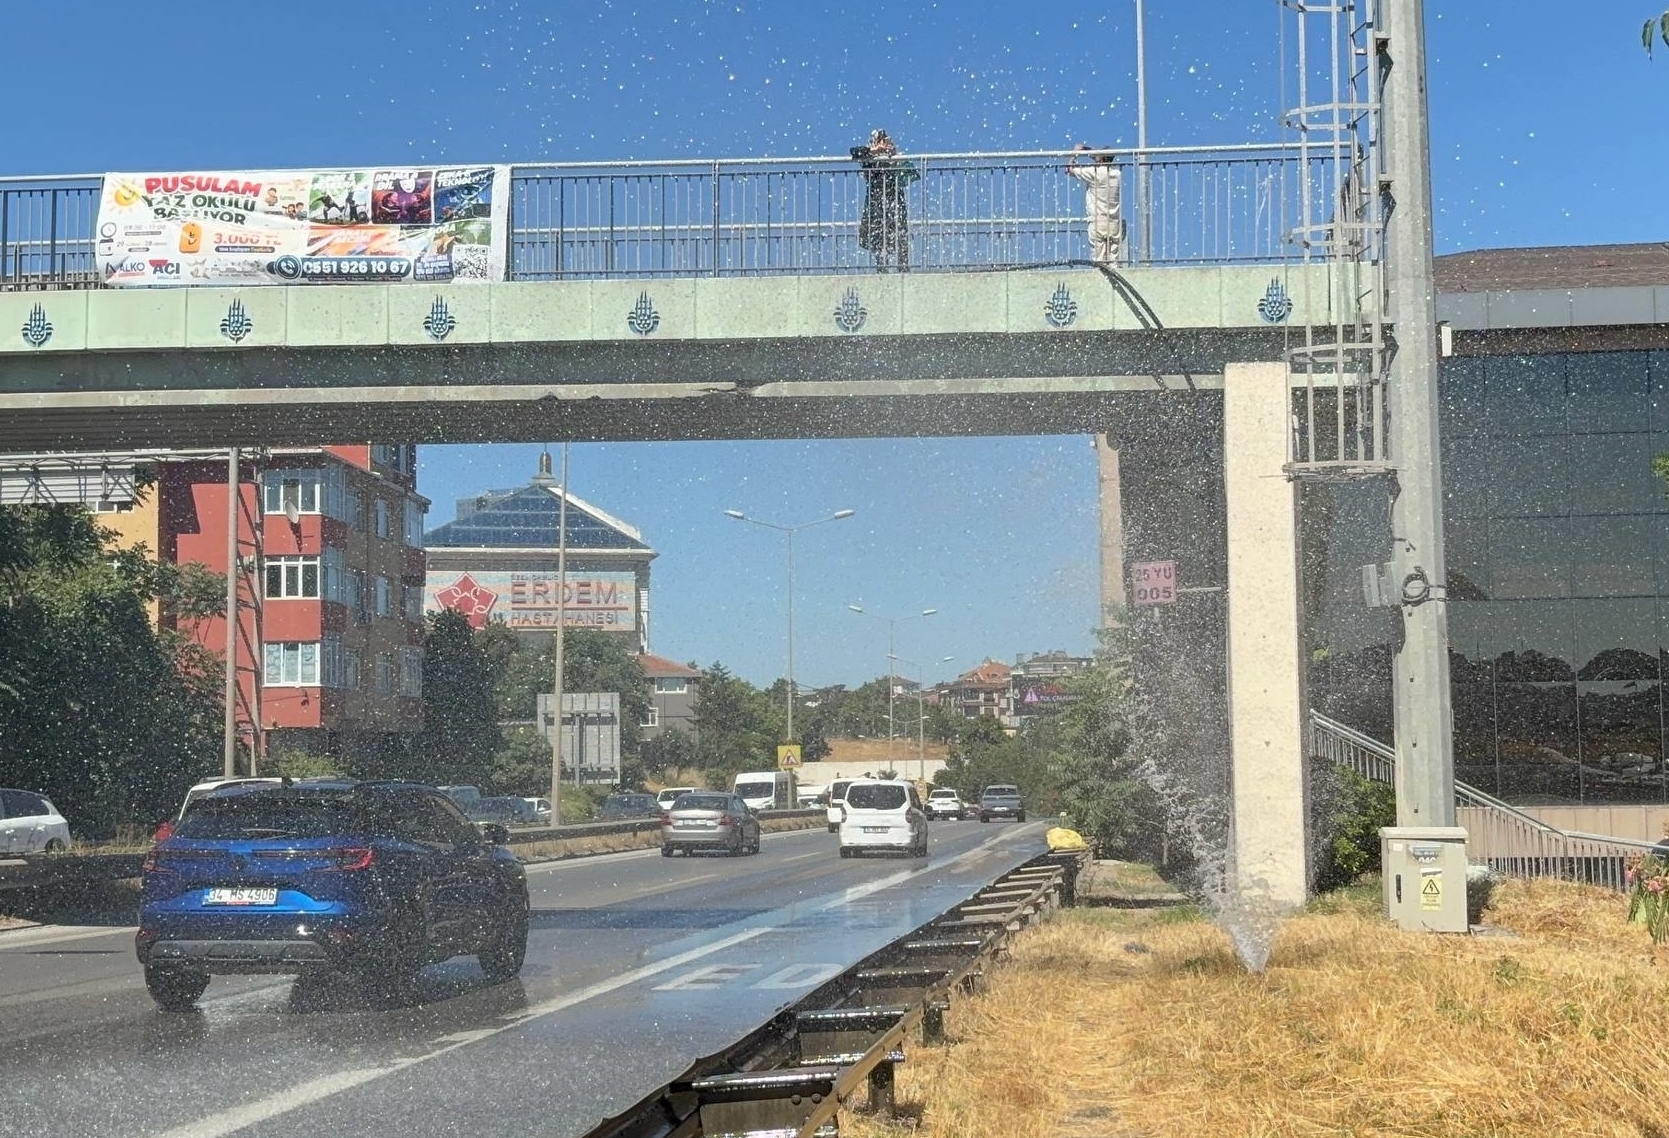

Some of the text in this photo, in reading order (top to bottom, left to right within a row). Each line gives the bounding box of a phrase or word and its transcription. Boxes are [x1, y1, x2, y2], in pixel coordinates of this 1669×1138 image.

[145, 175, 262, 198] PUSULAM
[191, 195, 256, 212] OKULU
[154, 207, 246, 225] BAIYOR
[303, 260, 338, 274] 0551
[341, 260, 368, 274] 926
[371, 260, 387, 274] 10
[389, 260, 409, 274] 67
[511, 581, 617, 604] ERDEM
[209, 888, 223, 900] 34
[248, 888, 276, 900] 4906
